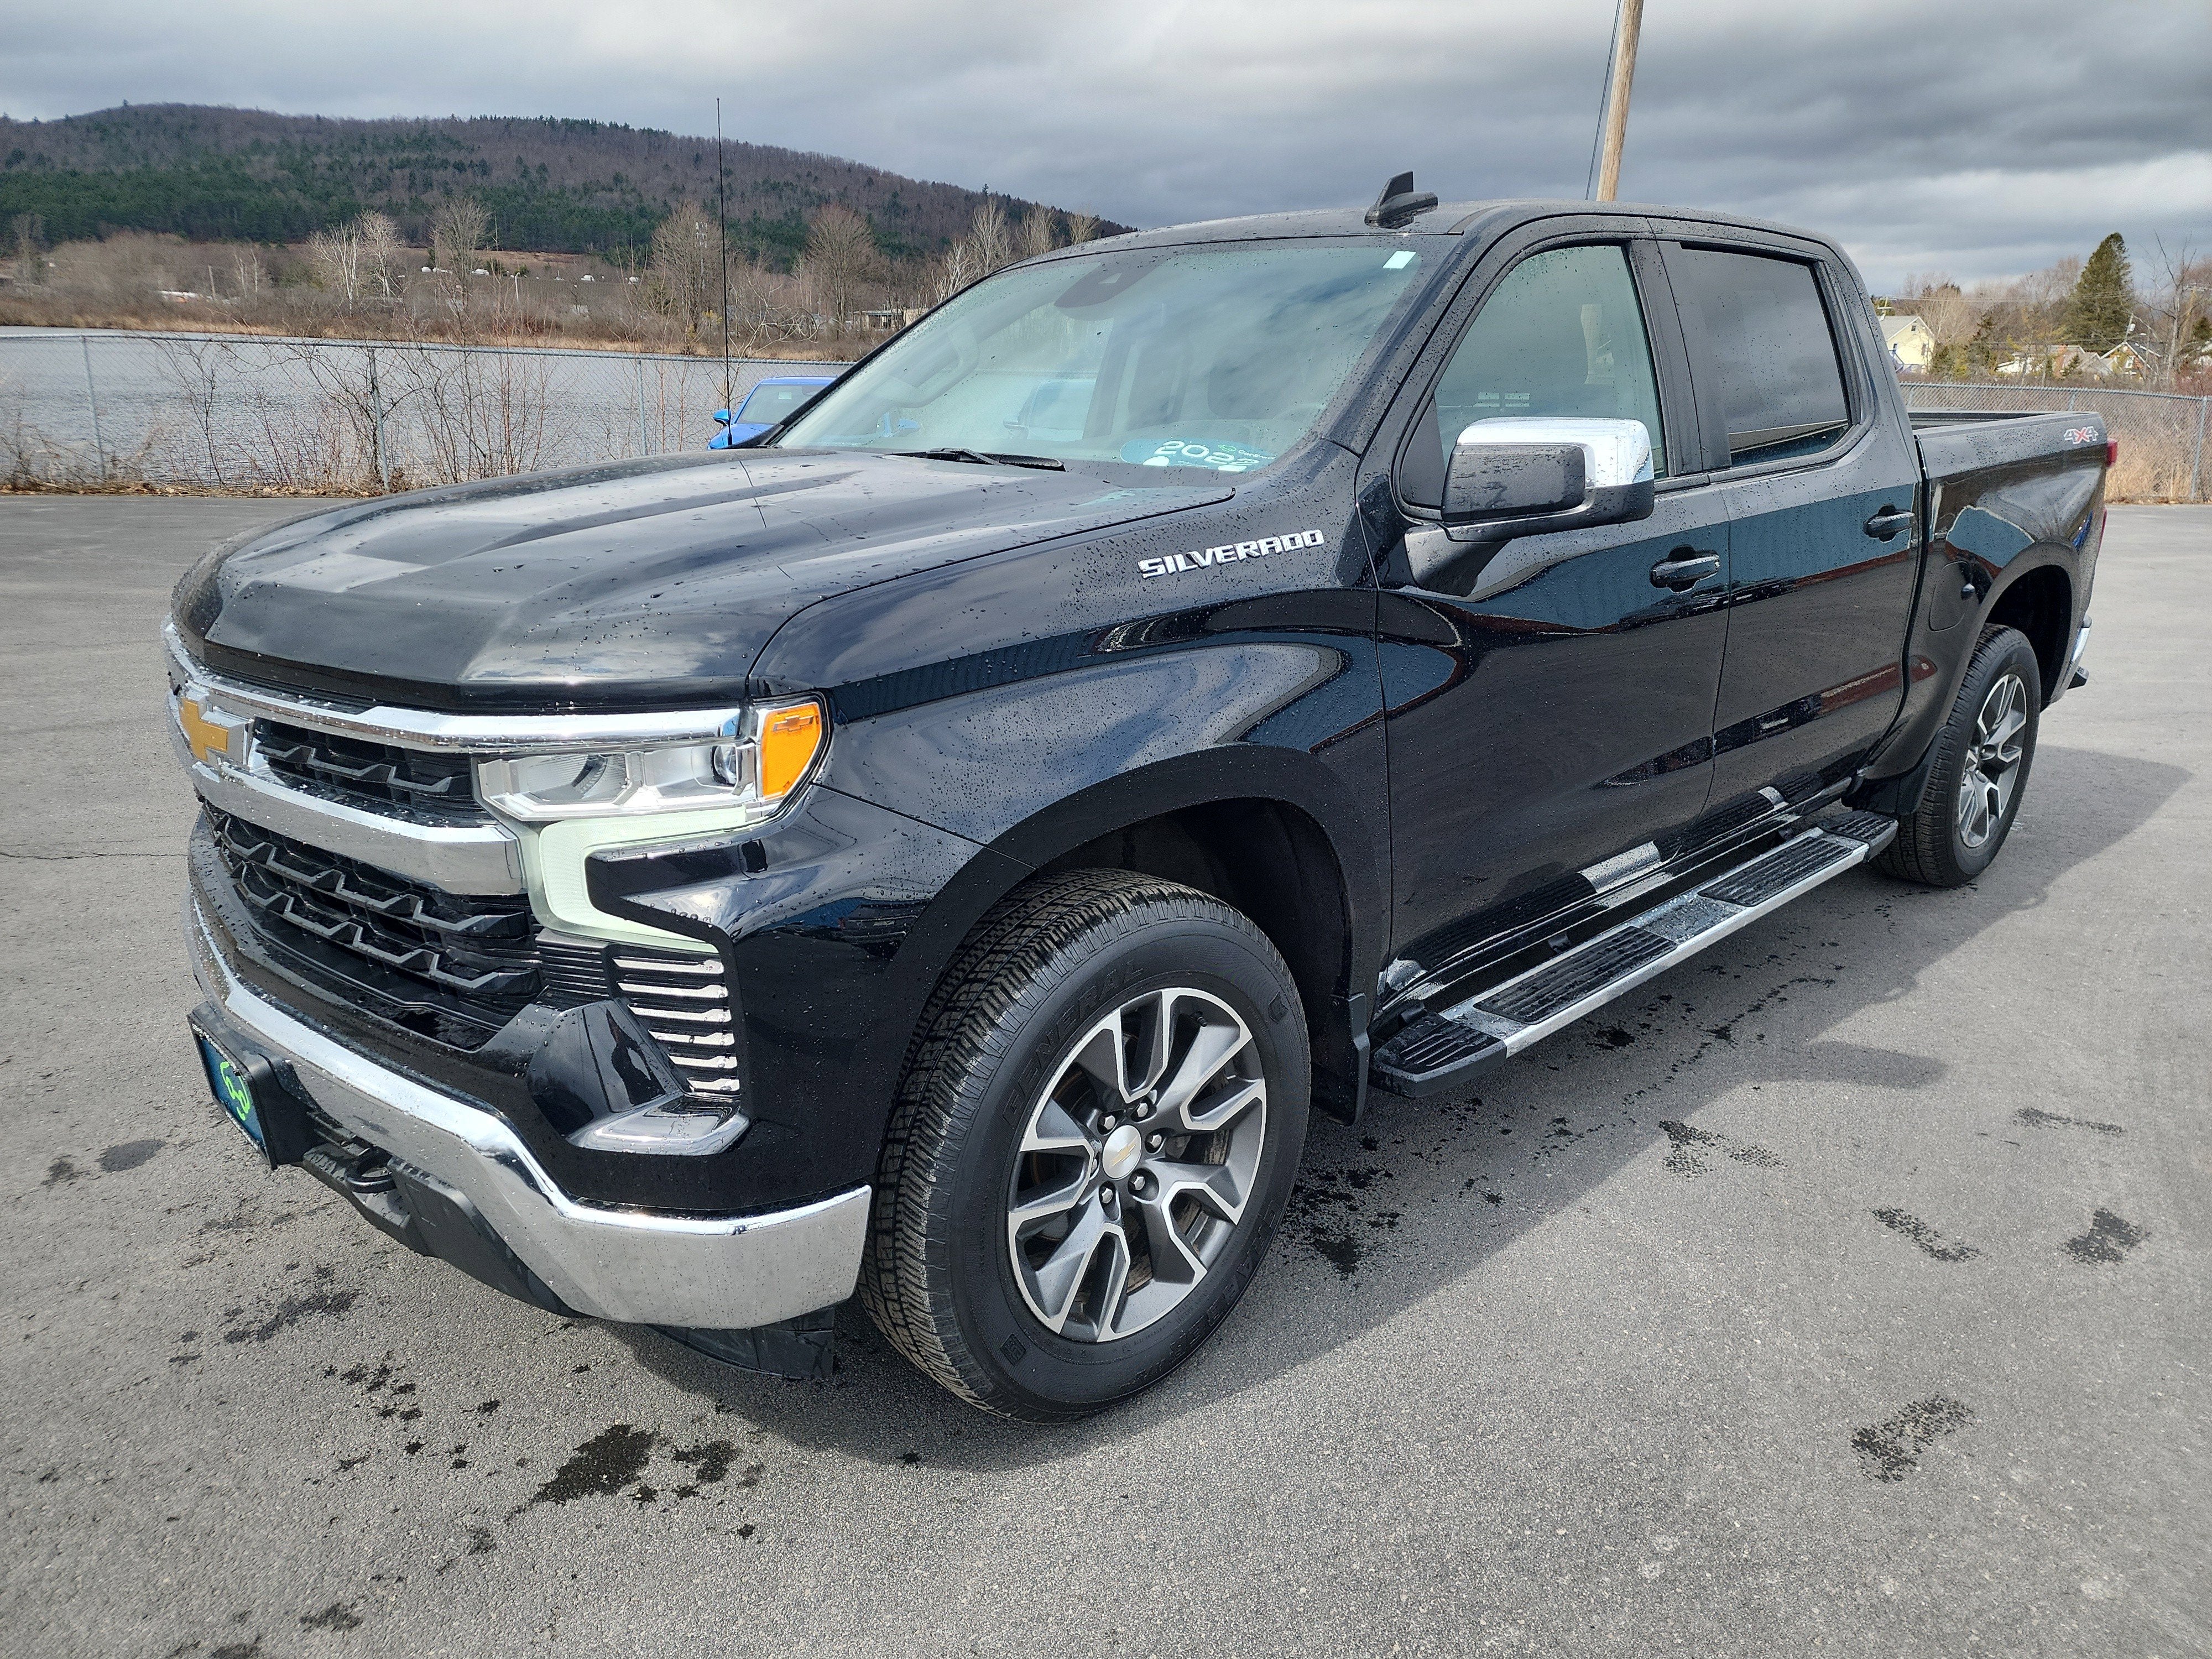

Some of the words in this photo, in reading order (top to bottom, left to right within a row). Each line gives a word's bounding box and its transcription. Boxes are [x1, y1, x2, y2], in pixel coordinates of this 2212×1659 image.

[1154, 440, 1260, 466] 2022
[2064, 426, 2099, 444] 4X4
[1138, 529, 1325, 579] SILVERADO
[1001, 959, 1145, 1129] GENERAL
